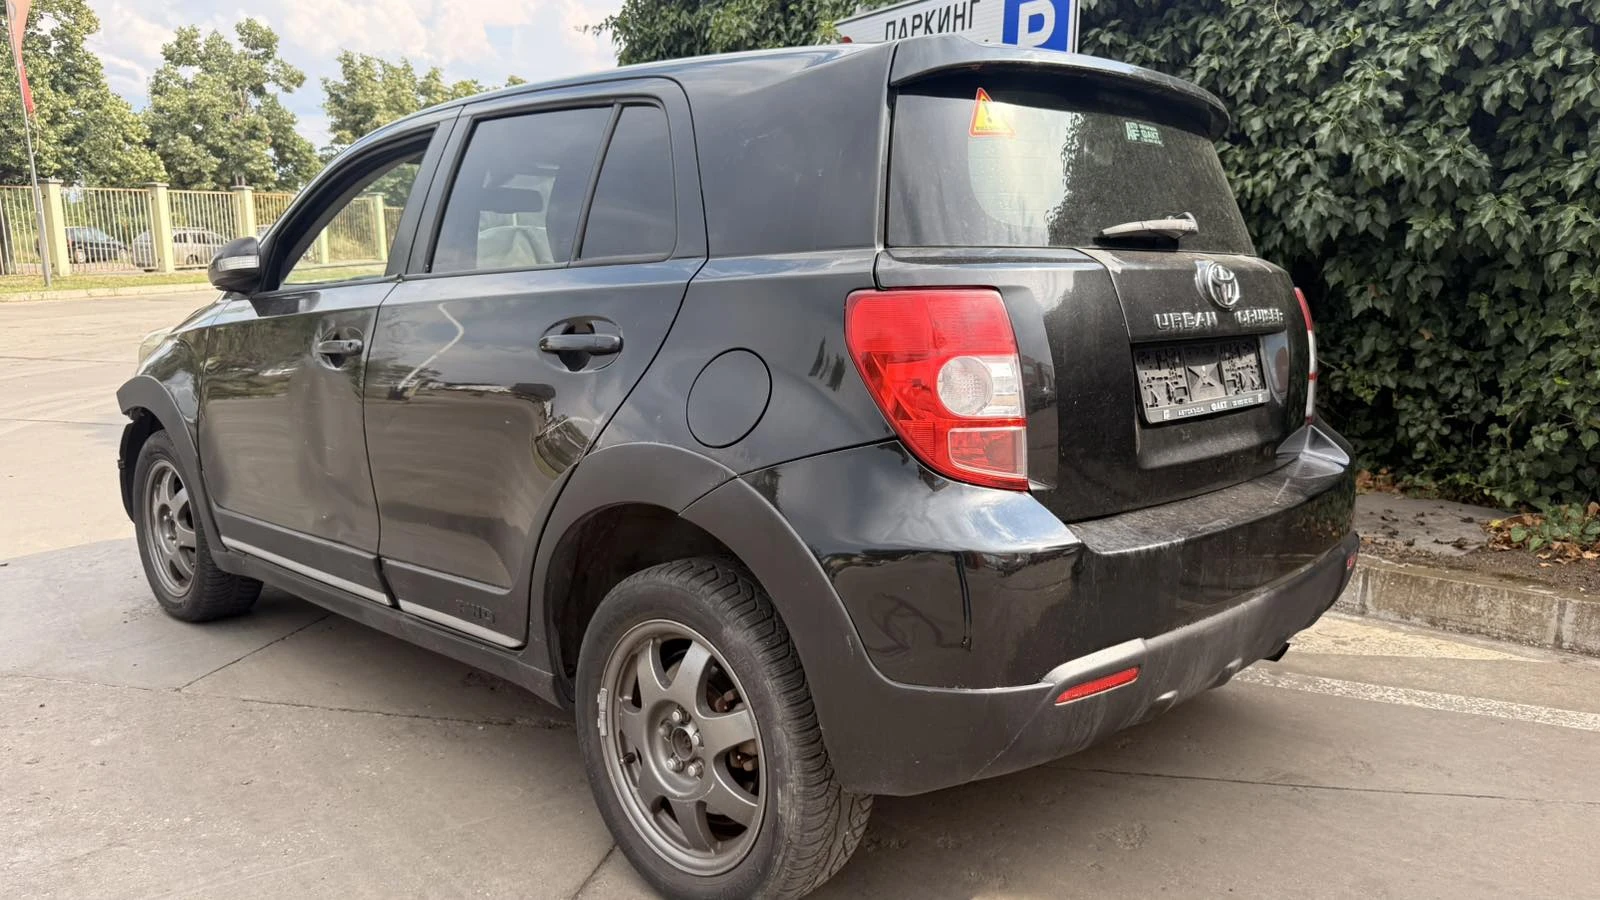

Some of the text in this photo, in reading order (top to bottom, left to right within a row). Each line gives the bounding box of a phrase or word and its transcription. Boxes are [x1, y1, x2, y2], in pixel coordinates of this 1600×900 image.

[885, 0, 981, 41] ПАРКИНГ
[1017, 0, 1056, 48] P
[1154, 311, 1218, 331] URBAN
